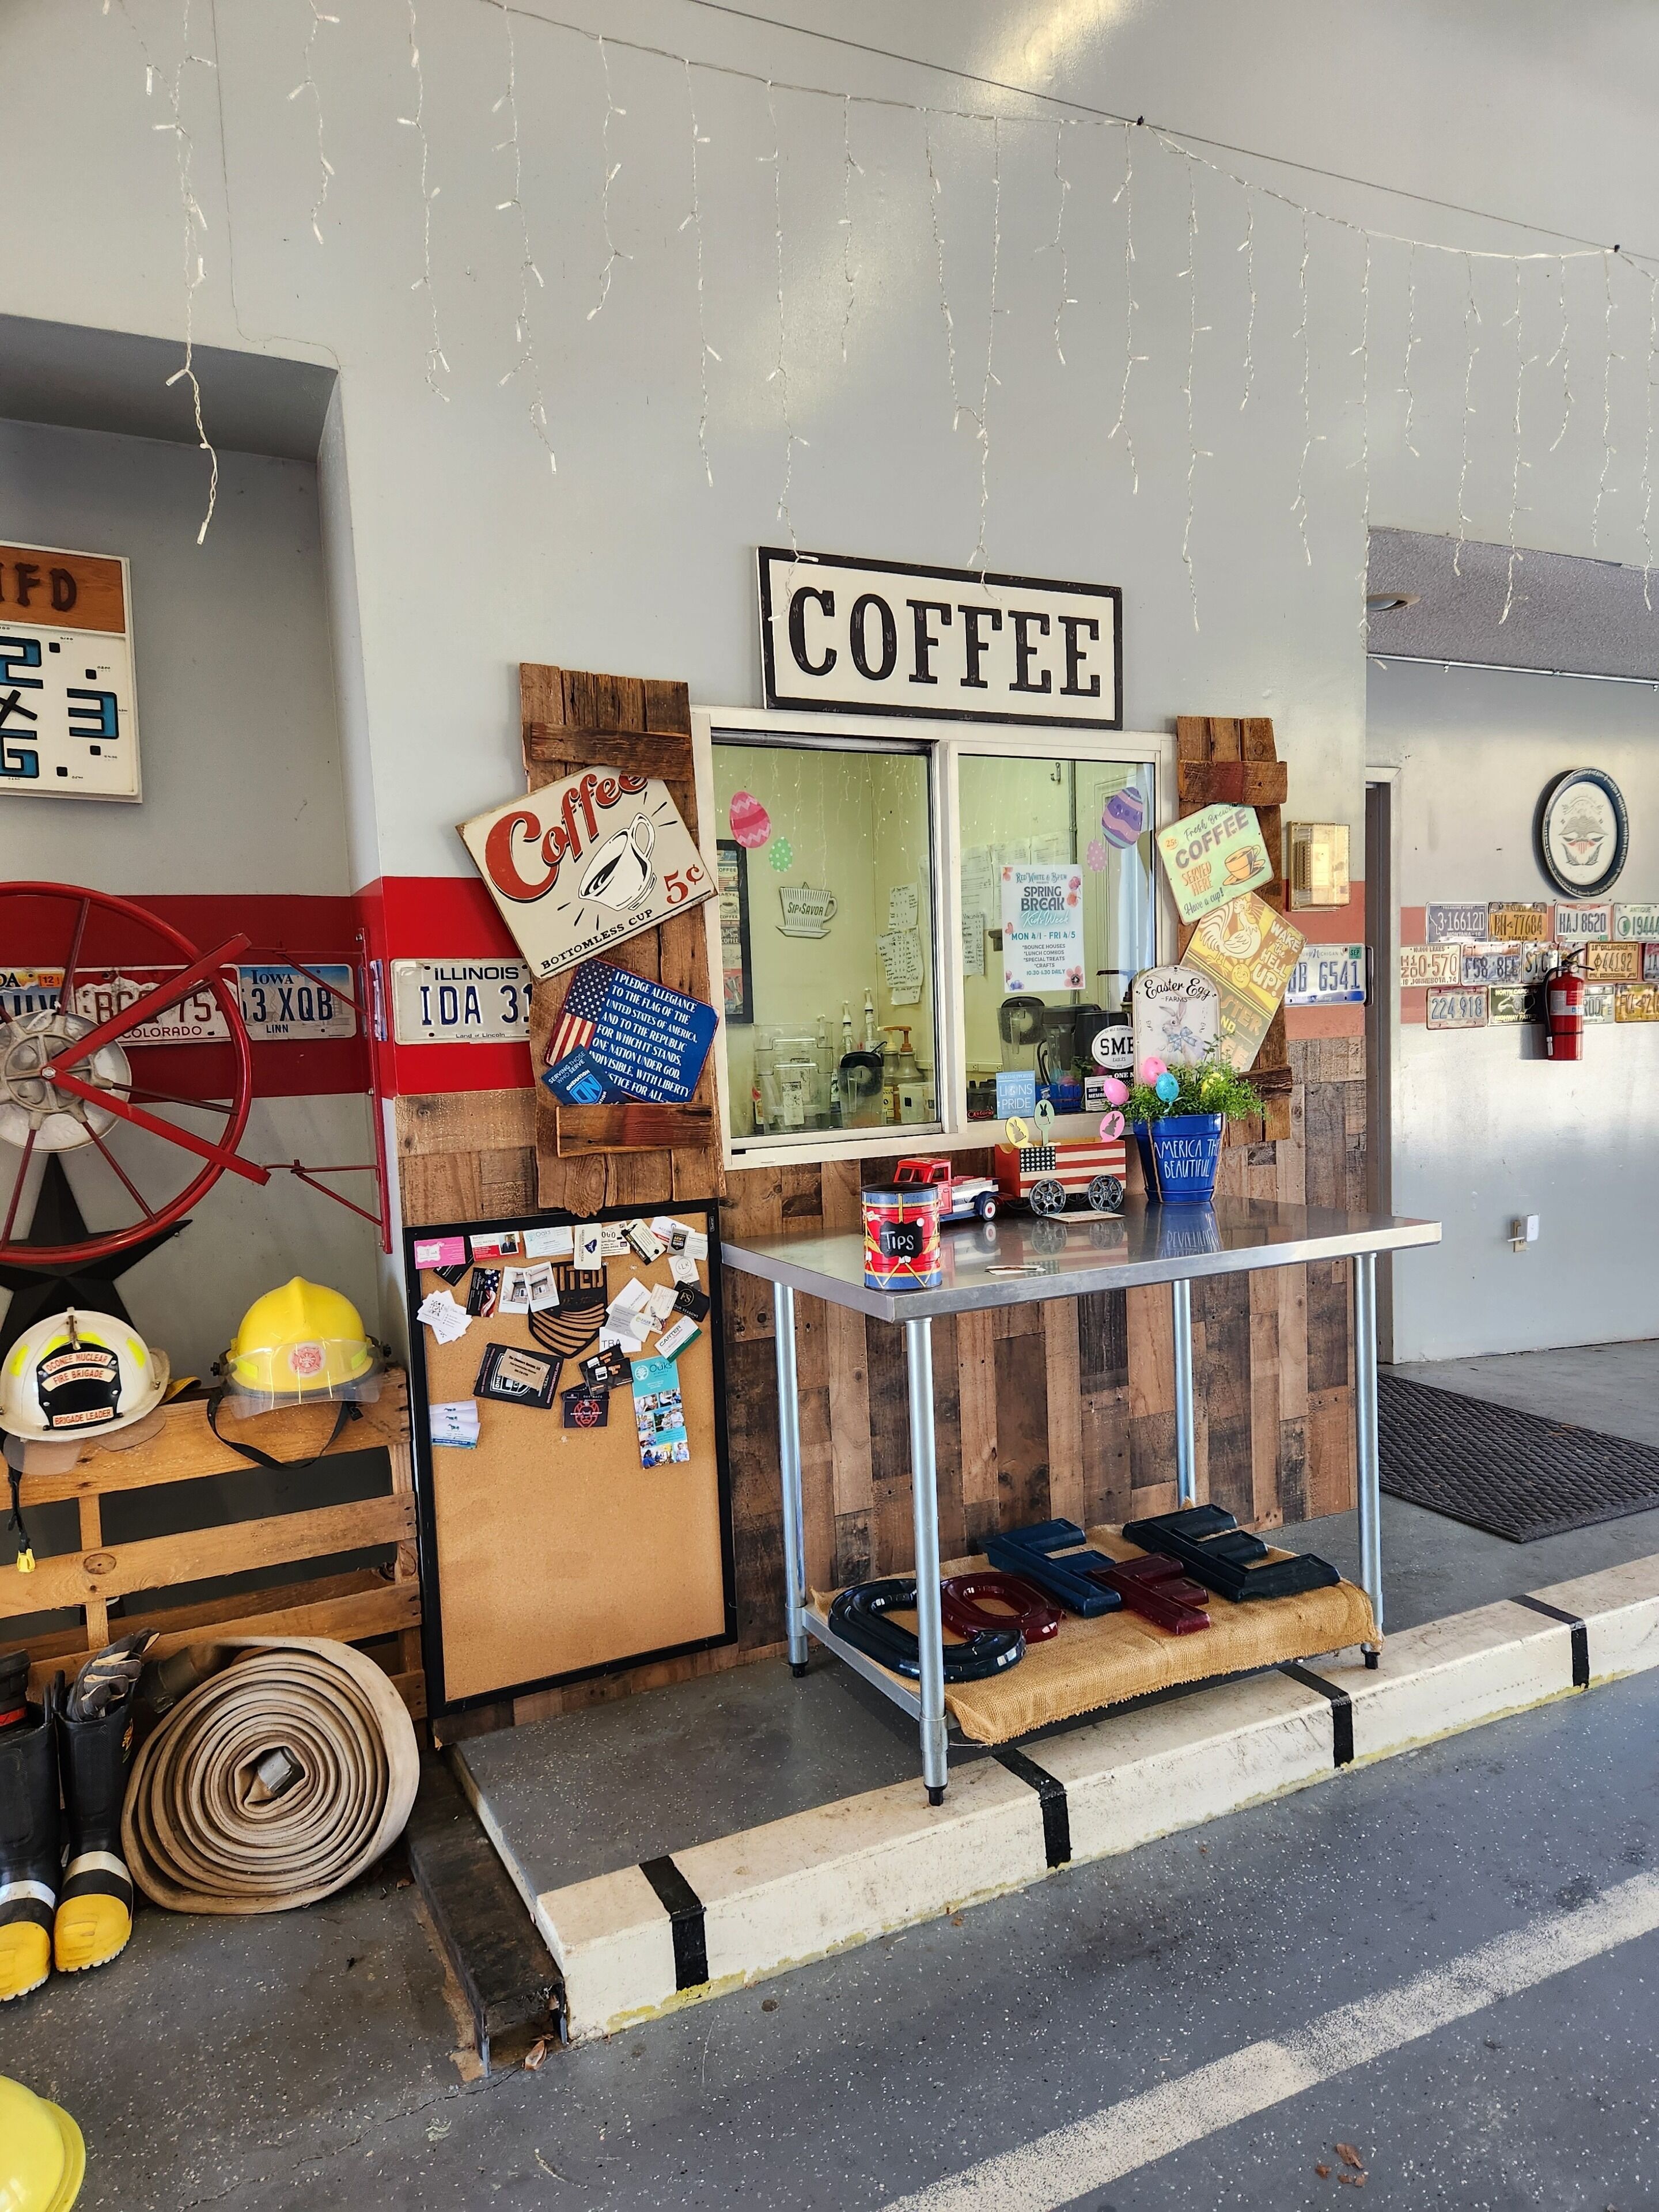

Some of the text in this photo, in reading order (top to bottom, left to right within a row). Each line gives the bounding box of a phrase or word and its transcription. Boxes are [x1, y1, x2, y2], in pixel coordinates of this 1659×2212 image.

[789, 586, 1101, 698] COFFEE
[66, 688, 119, 740] 3
[484, 773, 648, 903] Coffee
[1175, 808, 1249, 869] COFFEE
[1184, 819, 1208, 840] Fresh
[1181, 861, 1213, 887] SERVED
[1024, 886, 1062, 897] SPRING
[1191, 876, 1213, 897] HERE
[787, 902, 799, 914] SIP
[801, 903, 824, 916] SAVOR
[1021, 897, 1065, 911] BREAK
[1184, 900, 1203, 915] Have
[628, 908, 653, 926] CUP
[1043, 910, 1070, 926] Week
[1559, 912, 1578, 933] HAJ
[540, 923, 625, 970] BOTTOMLESS
[1012, 933, 1029, 941] MON
[1270, 920, 1302, 953] WAKE
[1274, 942, 1286, 959] the
[1259, 948, 1287, 978] HELL
[435, 967, 518, 981] ILLINOIS
[1319, 960, 1361, 991] 6541
[615, 972, 698, 1013] I PLEDGE ALLEGIANCE
[1144, 978, 1210, 1001] Easter Egg
[279, 986, 333, 1022] XQB
[419, 984, 483, 1026] IDA
[606, 998, 633, 1016] UNITED
[632, 1010, 657, 1026] STATES
[657, 1019, 666, 1029] OF
[612, 985, 691, 1025] TO THE FLAG OF THE
[1431, 995, 1483, 1020] 224 918
[122, 1025, 202, 1039] COLORADO
[266, 1024, 289, 1034] LINN
[596, 1024, 613, 1039] FOR
[615, 1031, 643, 1049] WHICH
[642, 1040, 653, 1053] IT
[601, 1012, 688, 1053] AND TO THE REPUBLIC
[592, 1037, 609, 1052] ONE
[609, 1044, 636, 1063] NATION
[637, 1054, 663, 1071] UNDER
[1100, 1037, 1134, 1055] SME
[548, 1051, 586, 1084] SERVING THOSE
[556, 1058, 586, 1084] WHO SERVE
[608, 1072, 631, 1090] STICE
[631, 1082, 649, 1097] FOR
[636, 1069, 658, 1085] WITH
[657, 1077, 692, 1098] LIBERTY
[1002, 1097, 1032, 1110] PRIDE
[1153, 1138, 1221, 1159] AMERICA THE
[1164, 1158, 1210, 1179] BEAUTIFUL
[536, 1230, 551, 1238] Oaks
[880, 1230, 915, 1251] TIPS
[683, 1308, 699, 1319] SEASONS
[659, 1325, 682, 1347] CARTER
[46, 1353, 108, 1372] OCONEE NUCLEAR
[52, 1370, 104, 1385] FIRE BRIGADE
[55, 1408, 111, 1426] BRIGADE LEADER
